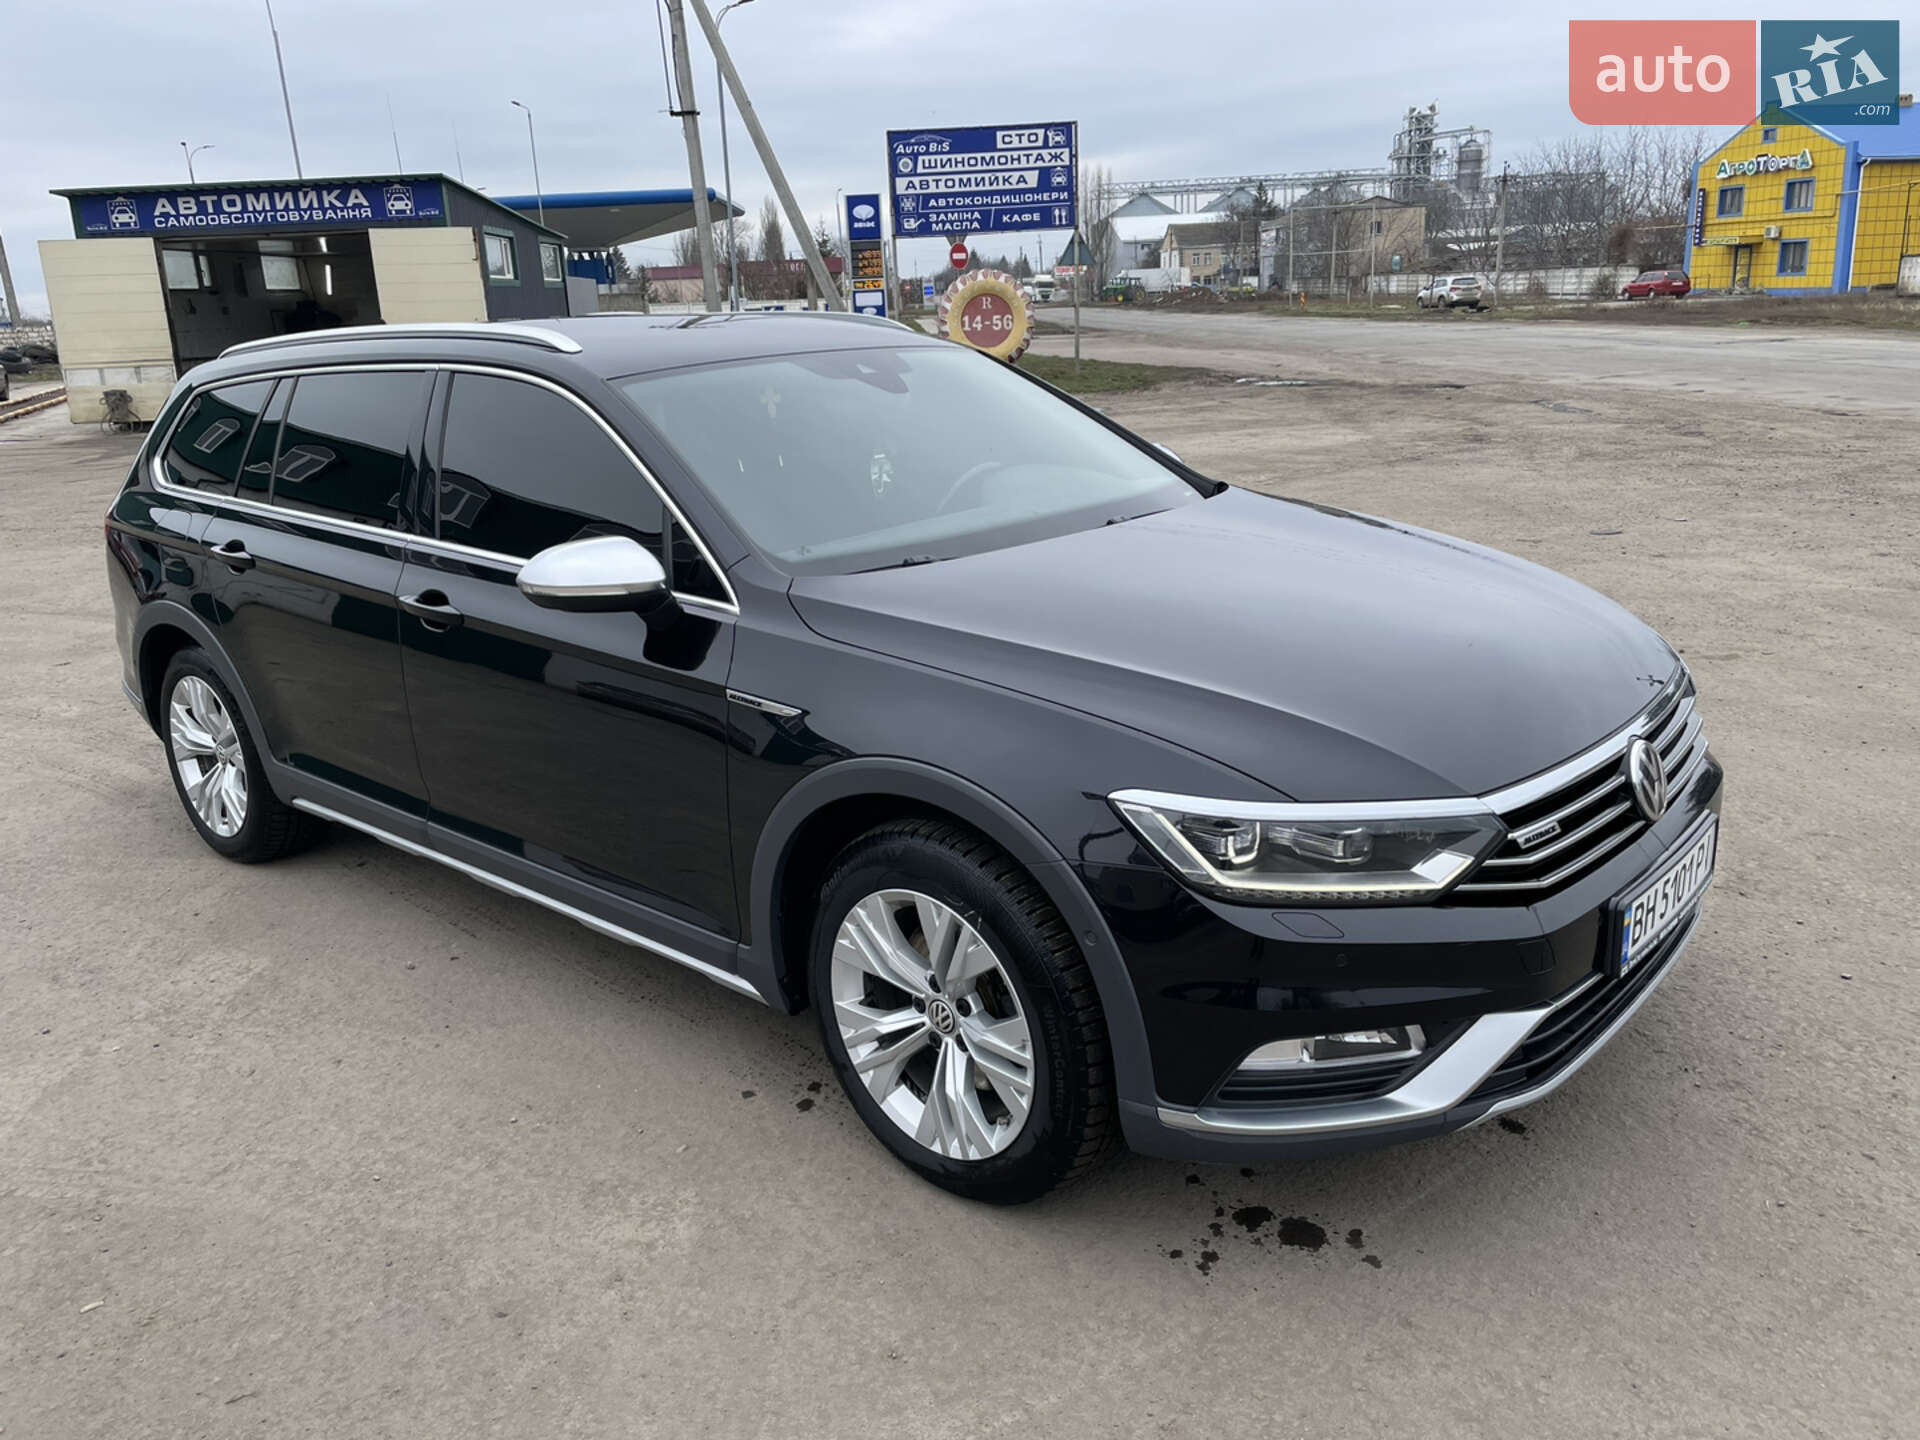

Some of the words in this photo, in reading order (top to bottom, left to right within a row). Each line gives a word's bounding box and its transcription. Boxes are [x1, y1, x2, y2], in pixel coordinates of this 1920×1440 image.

[1001, 132, 1040, 145] СТО
[921, 151, 1065, 170] ШИНОМОНТАЖ
[904, 173, 1028, 191] АВТОМИЙКА
[153, 187, 370, 216] АВТОМИЙКА
[928, 192, 1069, 208] АВТОКОНДИЦІОНЕРИ
[154, 207, 373, 228] САМООБСЛУГОВУВАННЯ
[928, 211, 982, 222] ЗАМІНА
[1002, 212, 1041, 223] КАФЕ
[931, 221, 981, 232] МАСЛА
[981, 296, 992, 309] R
[961, 314, 1013, 331] 14-56
[1631, 888, 1658, 948] BH
[1660, 853, 1695, 920] 5101
